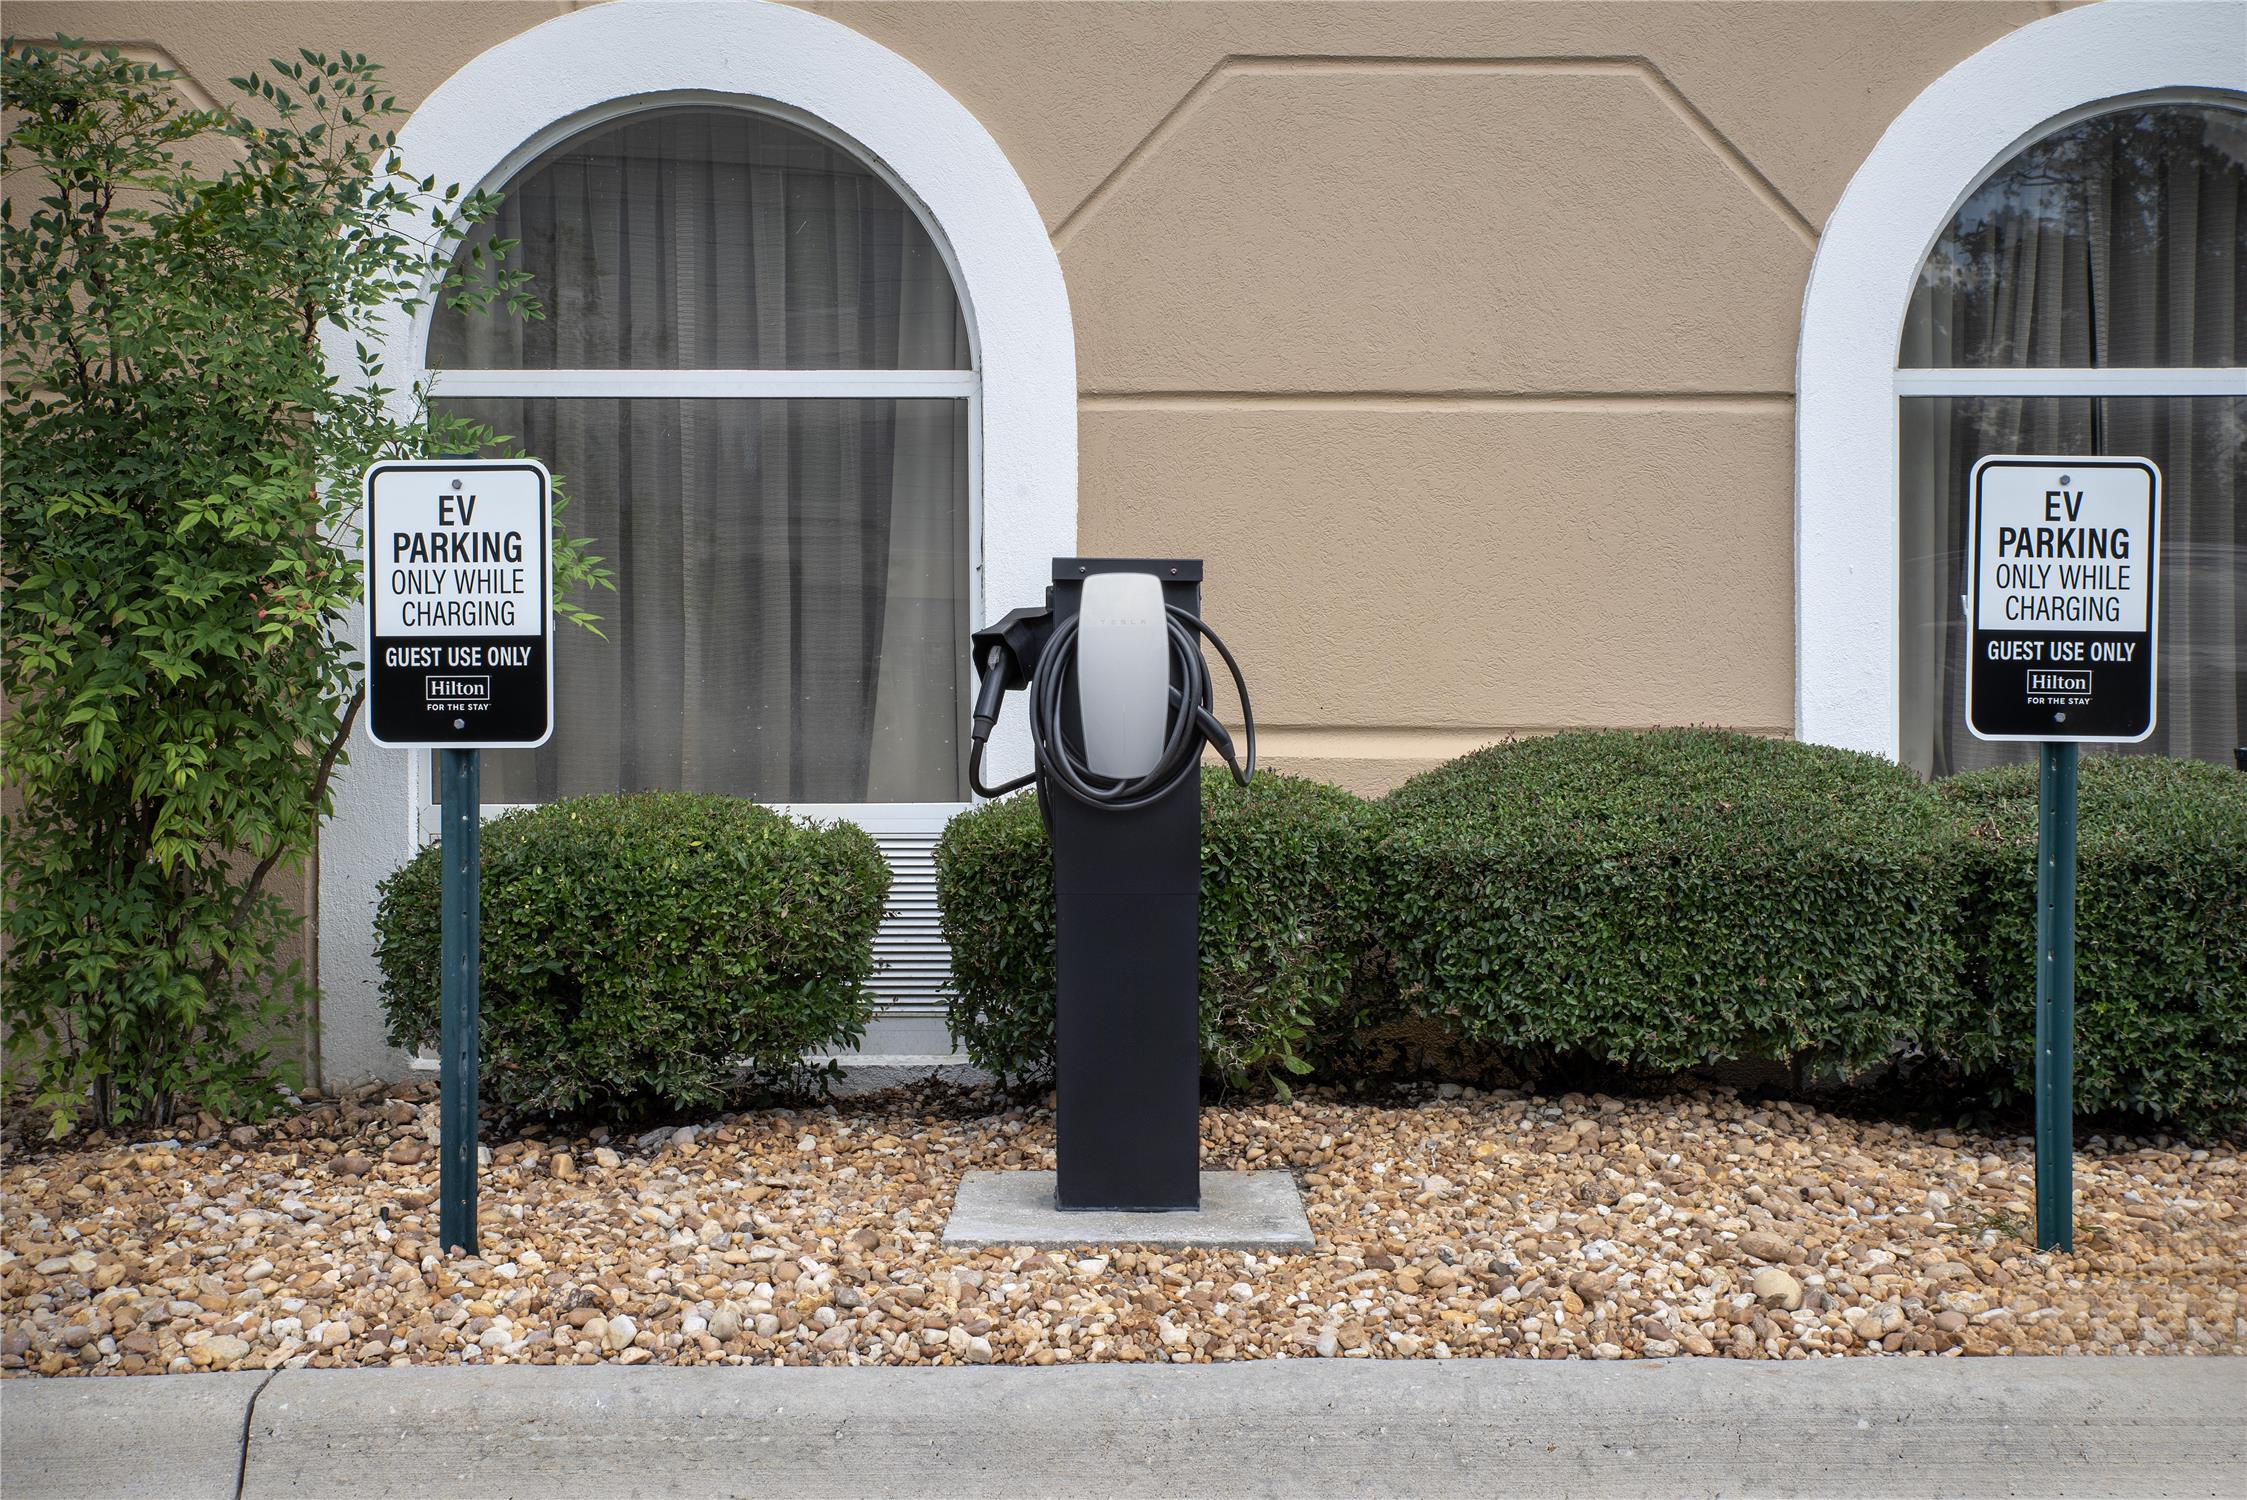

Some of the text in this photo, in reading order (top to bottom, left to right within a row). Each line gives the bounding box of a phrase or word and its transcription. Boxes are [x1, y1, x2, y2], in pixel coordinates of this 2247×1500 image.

[438, 495, 476, 526] EV
[2045, 490, 2084, 522] EV
[393, 531, 523, 563] PARKING
[1998, 526, 2130, 559] PARKING
[391, 568, 524, 595] ONLY WHILE
[1996, 563, 2130, 590] ONLY WHILE
[402, 601, 515, 627] CHARGING
[2005, 595, 2120, 622] CHARGING
[385, 646, 531, 667] GUEST USE ONLY
[1987, 640, 2136, 662] GUEST USE ONLY
[431, 680, 485, 696] Hilton
[2032, 674, 2087, 690] Hilton
[427, 703, 489, 711] FOR THE STAY
[2027, 697, 2090, 705] FOR THE STAY
